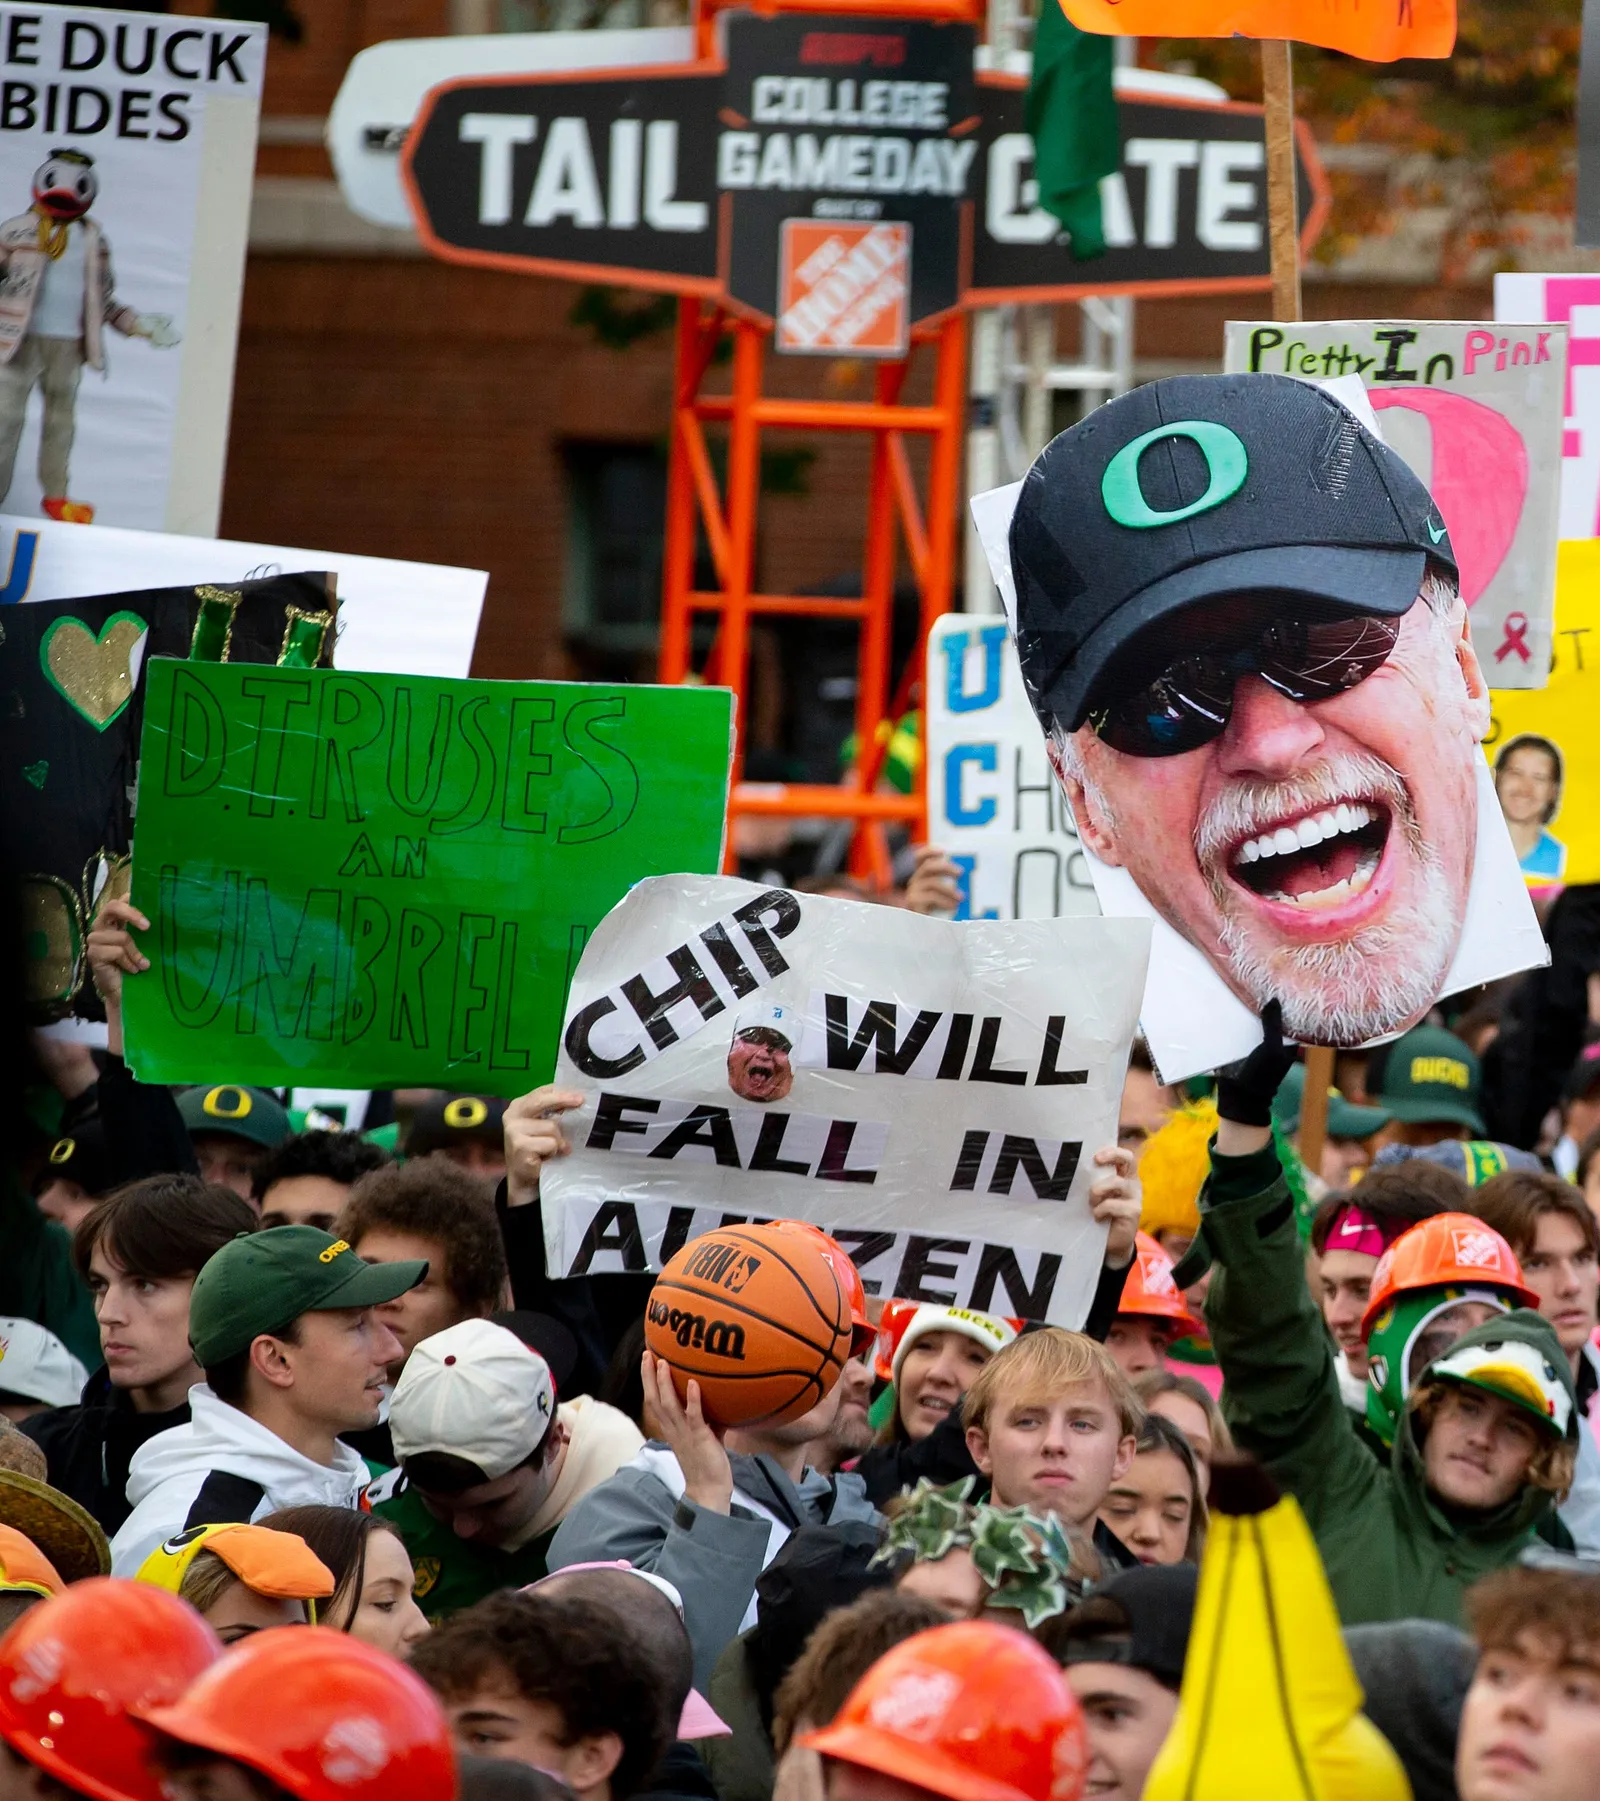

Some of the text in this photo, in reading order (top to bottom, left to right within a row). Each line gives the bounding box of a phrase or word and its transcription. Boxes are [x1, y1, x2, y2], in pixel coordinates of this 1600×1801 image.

[61, 20, 252, 84] DUCK
[0, 80, 193, 142] BIDES
[752, 75, 949, 130] COLLEGE
[459, 113, 708, 231] TAIL
[717, 131, 979, 196] GAMEDAY
[1249, 328, 1551, 385] Pretty In Pink
[338, 835, 427, 879] AN
[564, 888, 802, 1079] CHIP
[824, 993, 1090, 1087] WILL
[585, 1092, 1083, 1202] FALL IN
[565, 1200, 1063, 1324] AUZEN
[681, 1240, 743, 1287] NBA
[648, 1297, 747, 1361] Wilson
